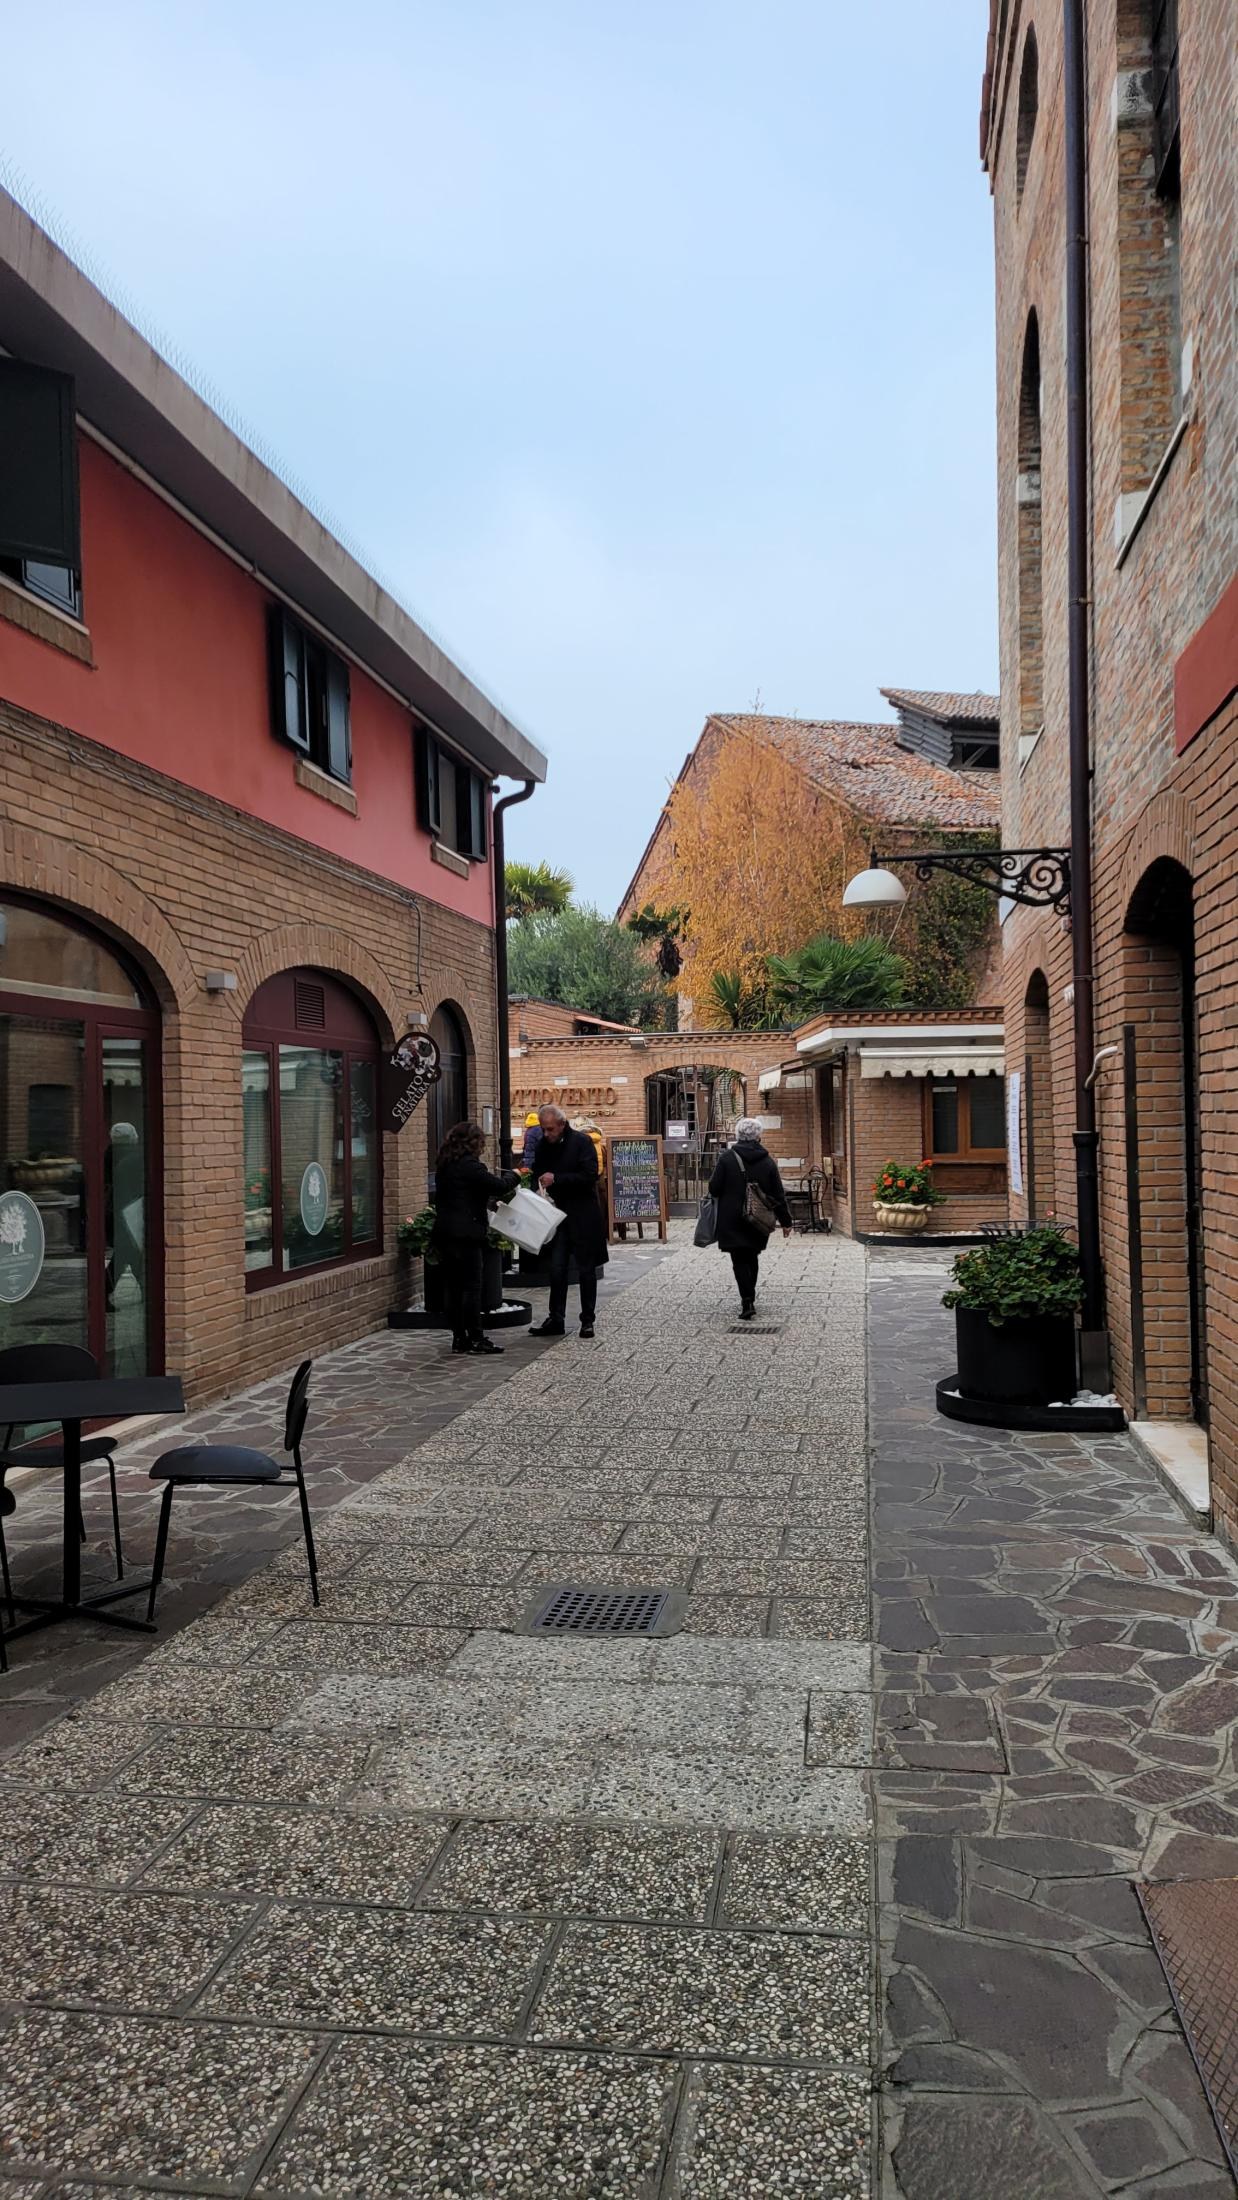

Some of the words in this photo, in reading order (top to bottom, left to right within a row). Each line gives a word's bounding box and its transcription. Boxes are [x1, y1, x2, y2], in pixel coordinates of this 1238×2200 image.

[391, 1075, 423, 1118] GELATO
[403, 1081, 430, 1116] NATURA
[511, 1087, 617, 1107] TTOVENTO
